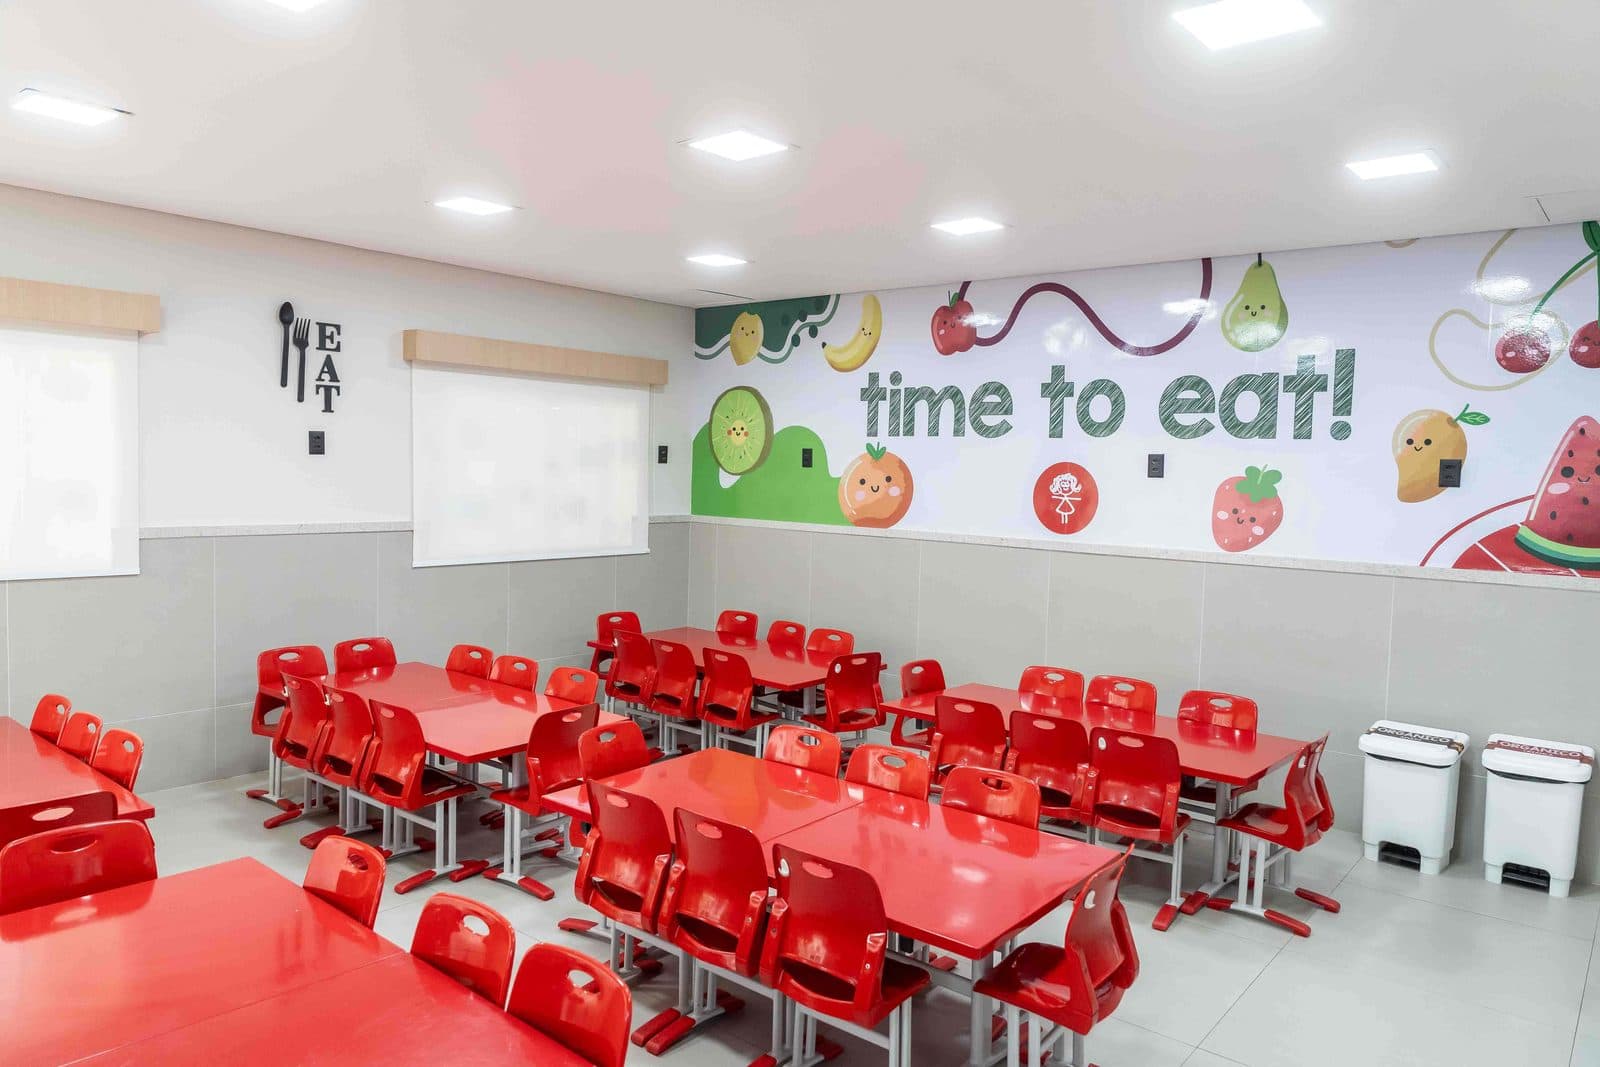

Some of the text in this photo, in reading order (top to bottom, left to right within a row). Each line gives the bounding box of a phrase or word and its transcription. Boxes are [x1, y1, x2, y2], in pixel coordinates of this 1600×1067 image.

[315, 321, 341, 413] EAT
[860, 348, 1356, 440] time to eat!
